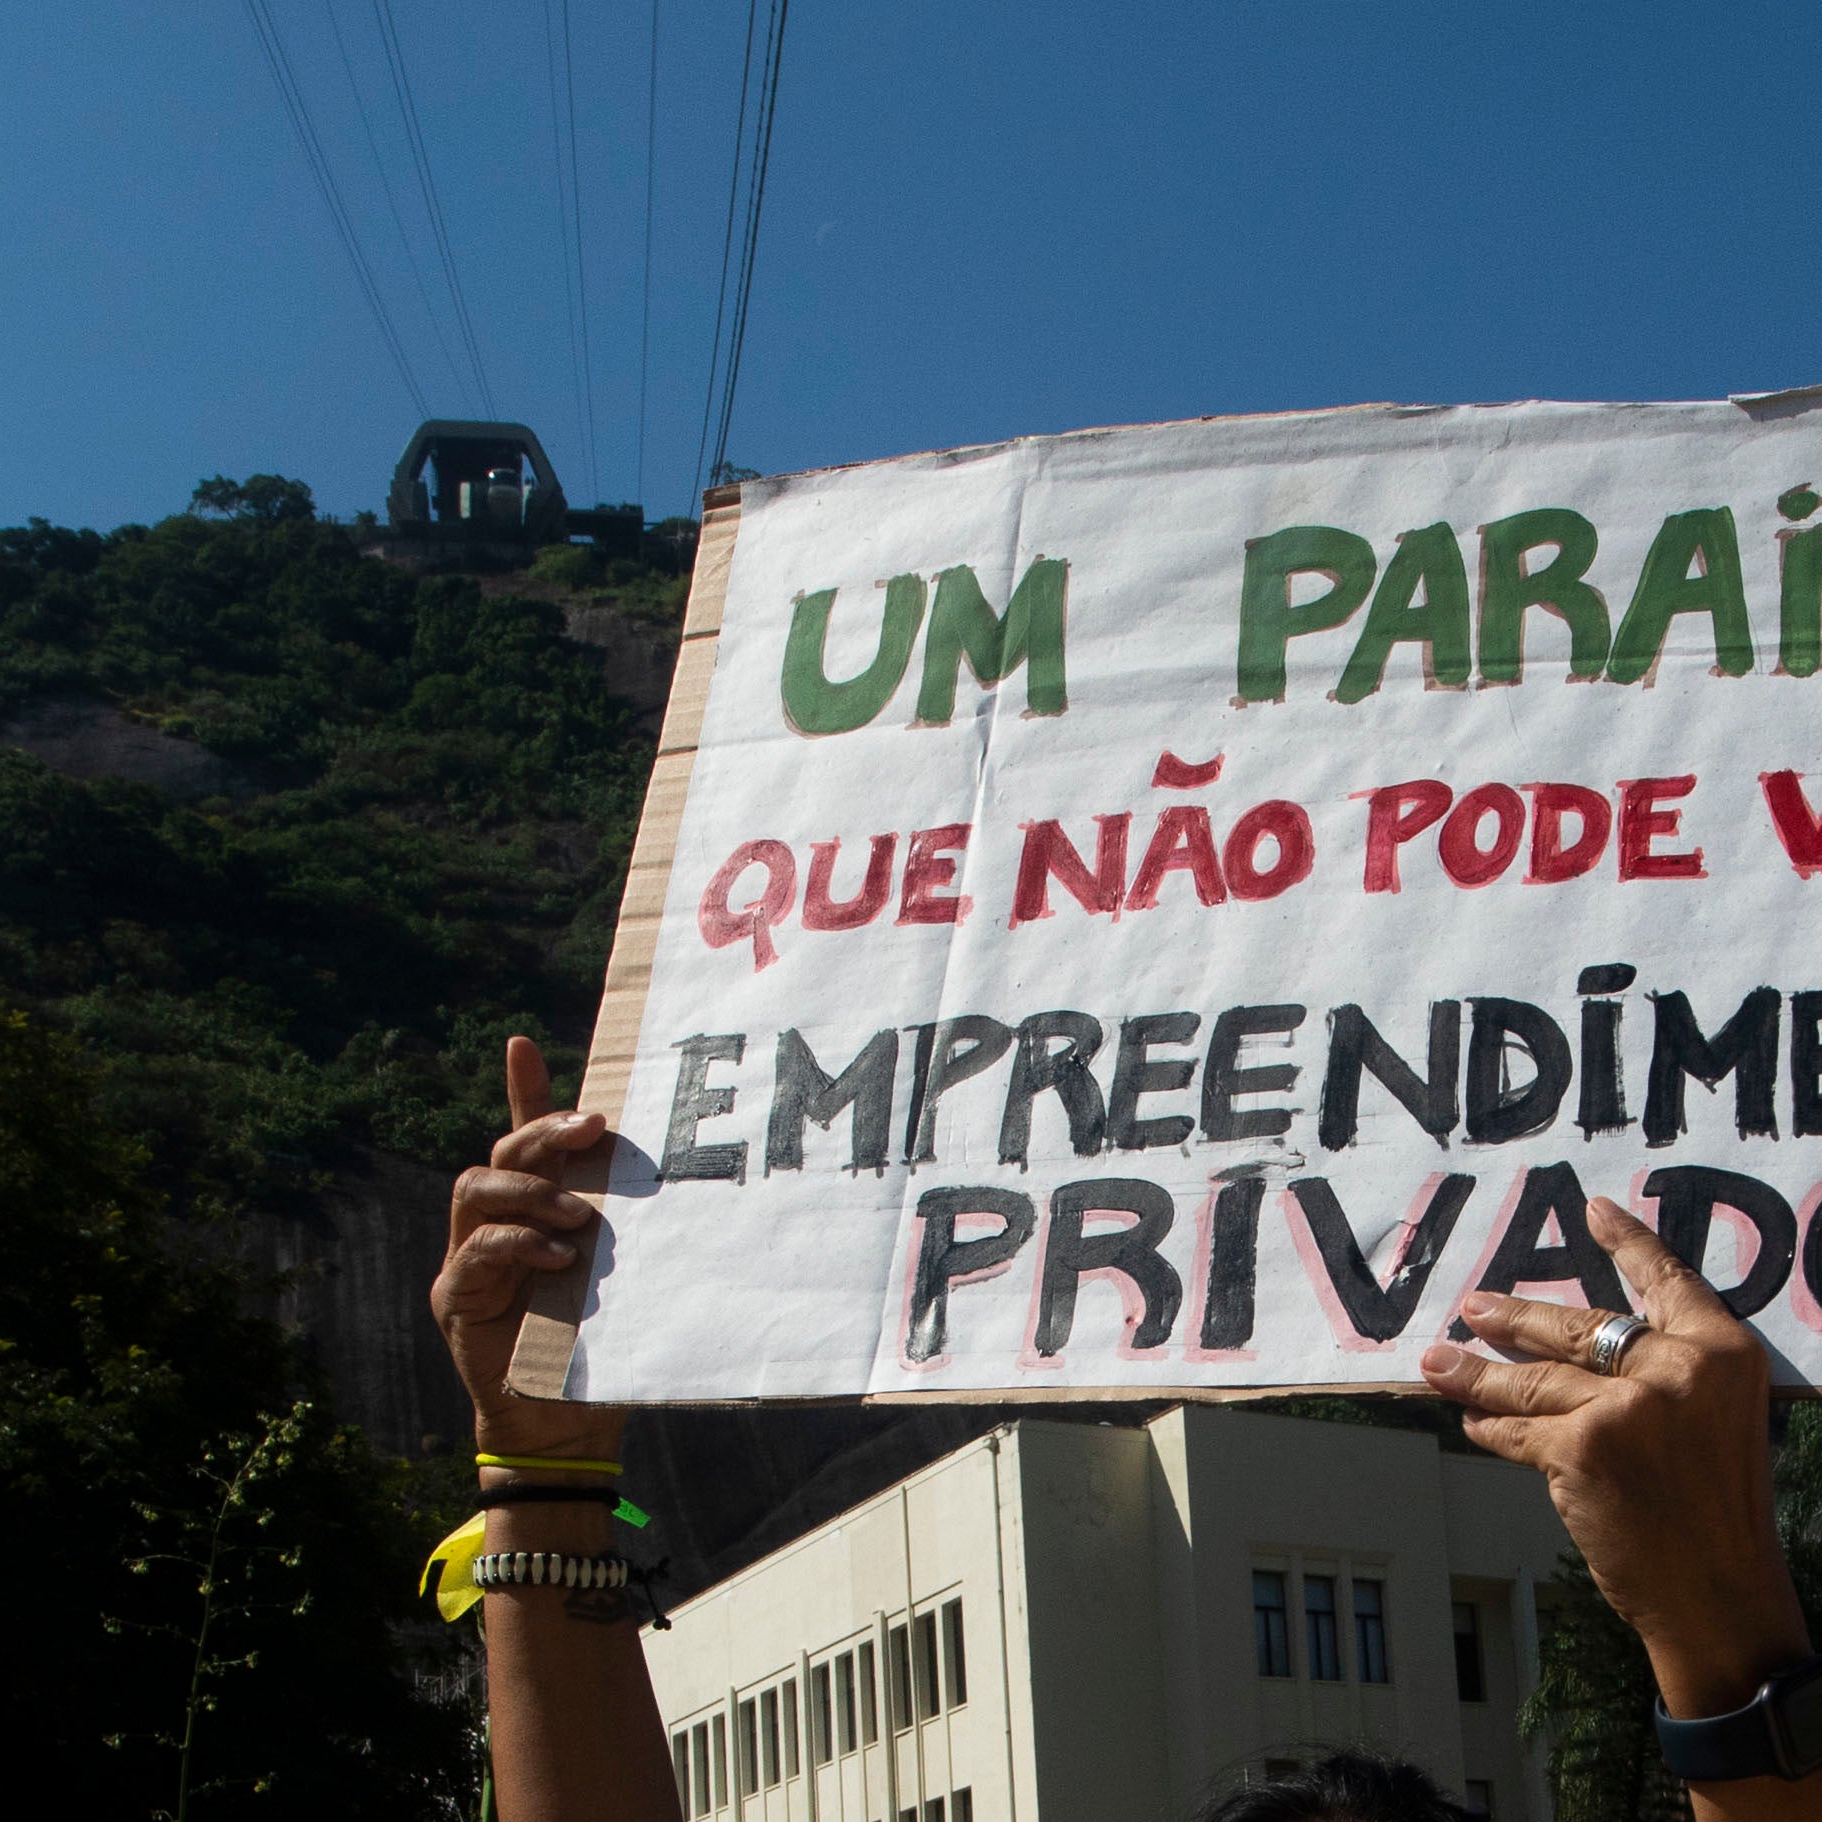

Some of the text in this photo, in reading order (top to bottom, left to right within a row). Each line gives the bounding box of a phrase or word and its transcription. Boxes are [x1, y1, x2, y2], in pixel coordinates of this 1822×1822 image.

[781, 554, 1071, 738] UM
[698, 818, 972, 970] QUE
[1010, 752, 1316, 930] NÃO
[1362, 770, 1708, 896] PODE
